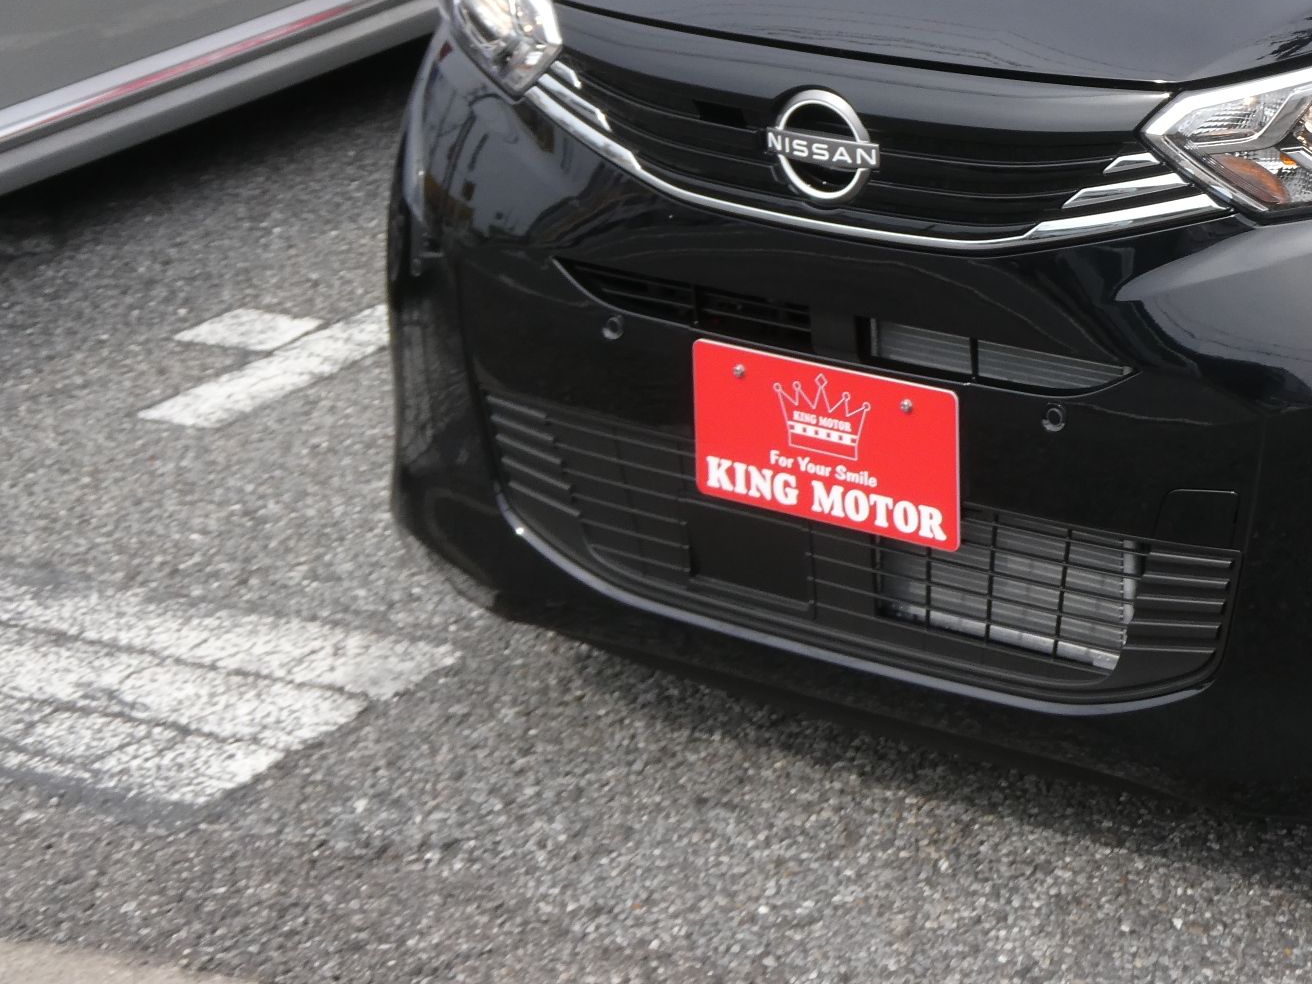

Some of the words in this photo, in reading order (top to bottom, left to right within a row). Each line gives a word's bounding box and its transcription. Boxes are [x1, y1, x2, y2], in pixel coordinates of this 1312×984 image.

[767, 131, 877, 167] NISSAN
[792, 409, 816, 426] KING
[817, 414, 852, 434] MOTOR
[769, 449, 794, 470] For
[796, 455, 832, 479] Your
[834, 463, 878, 489] Smile
[706, 455, 799, 505] KING
[810, 479, 947, 541] MOTOR
